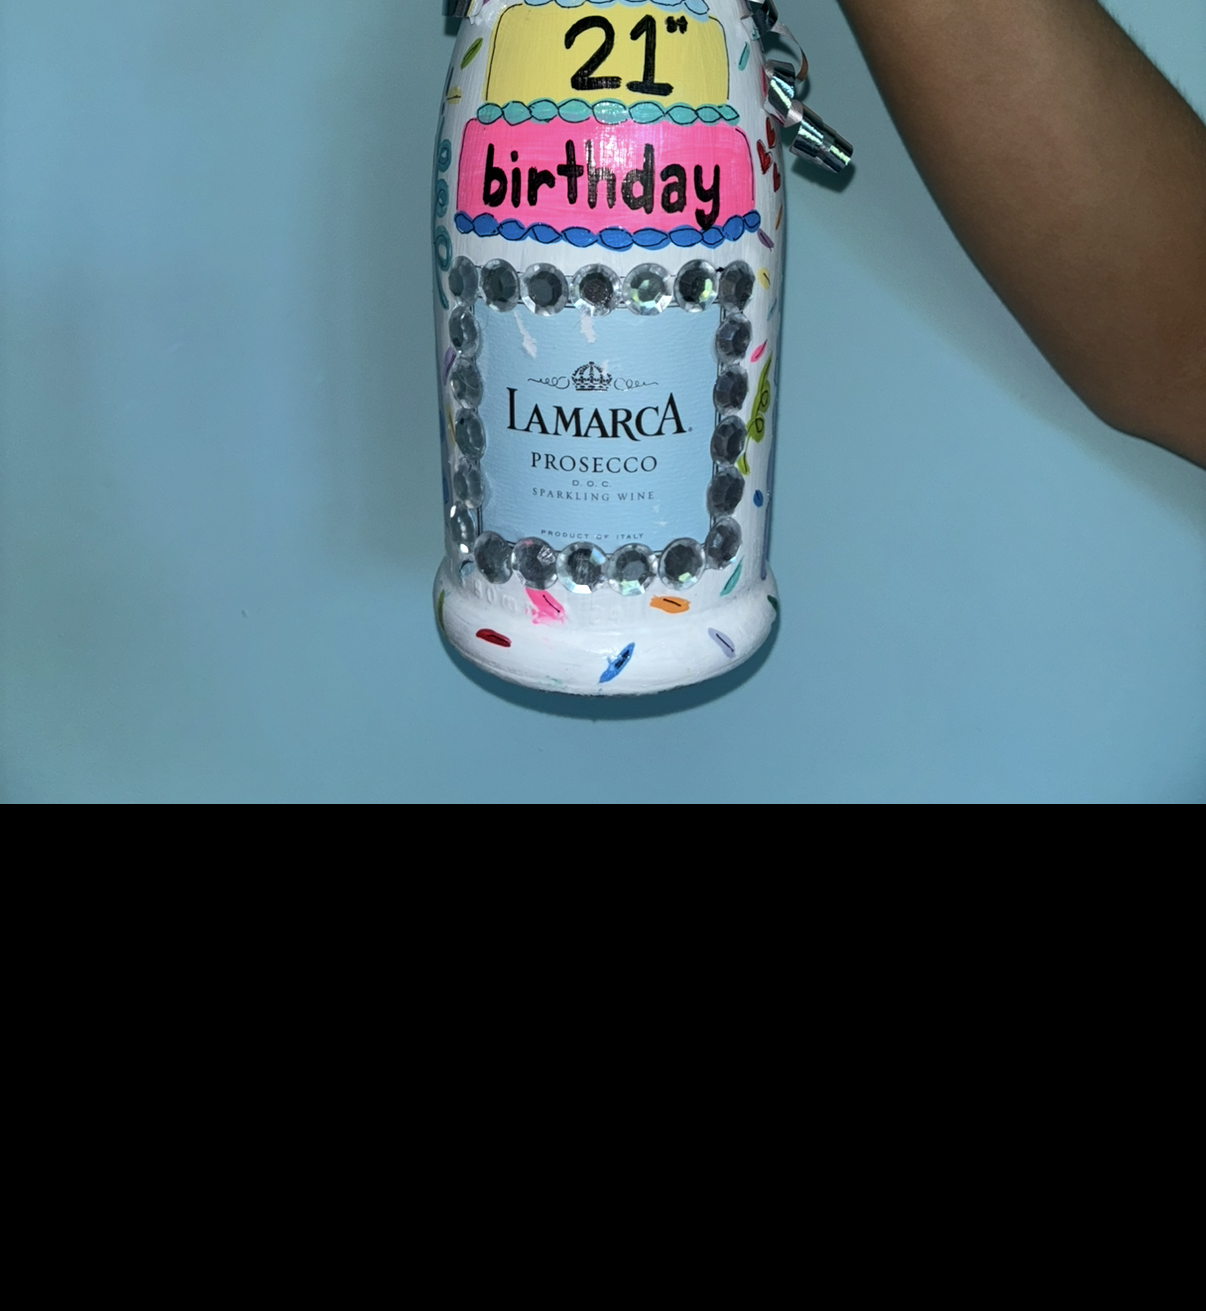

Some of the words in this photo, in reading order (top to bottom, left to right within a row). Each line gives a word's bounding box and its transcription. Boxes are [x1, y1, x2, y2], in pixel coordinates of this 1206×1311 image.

[482, 139, 720, 231] birthday
[531, 451, 658, 474] PROSECCO
[532, 487, 610, 502] SPARKLING
[617, 491, 655, 502] WINE
[540, 529, 590, 540] PRODUCT
[616, 532, 645, 541] ITALY
